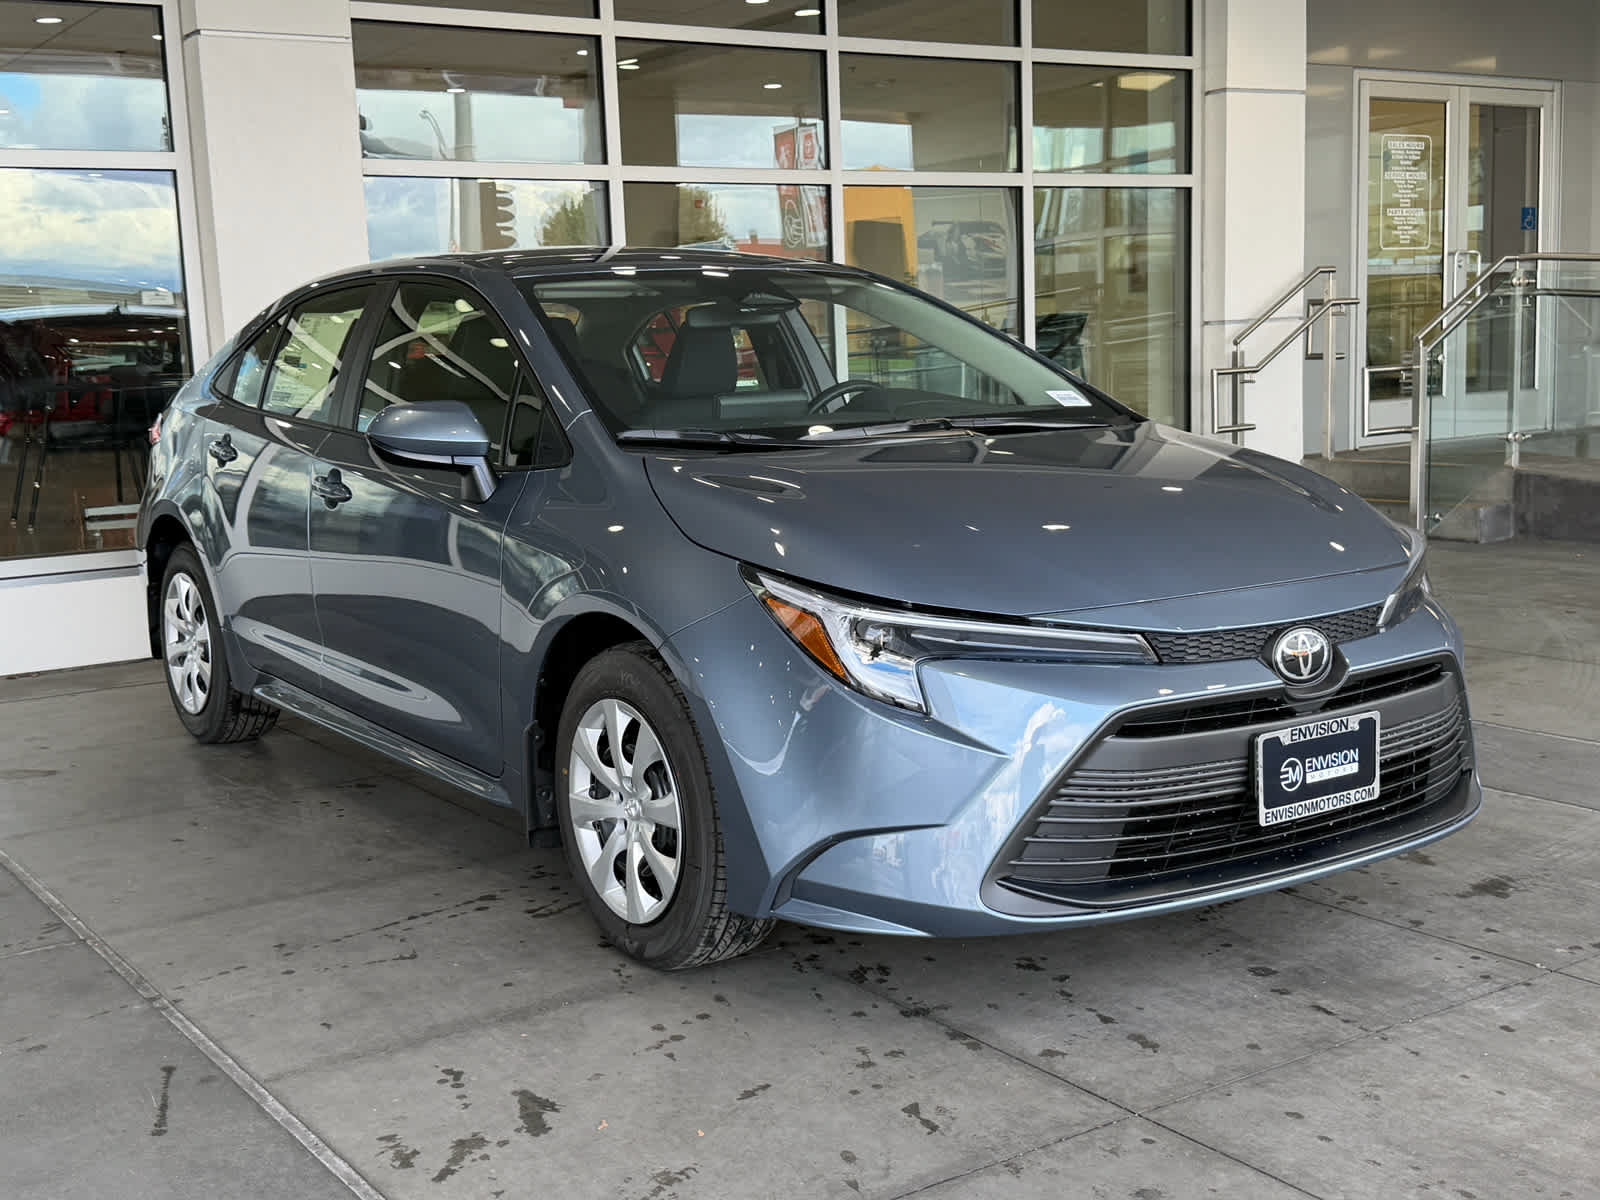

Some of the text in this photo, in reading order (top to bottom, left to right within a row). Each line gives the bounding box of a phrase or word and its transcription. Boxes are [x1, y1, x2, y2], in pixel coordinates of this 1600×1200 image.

[1290, 718, 1349, 742] ENVISION
[1305, 748, 1359, 772] ENVISION
[1309, 764, 1355, 780] MOTORS
[1264, 787, 1375, 824] ENVISIONMOTORS.COM
